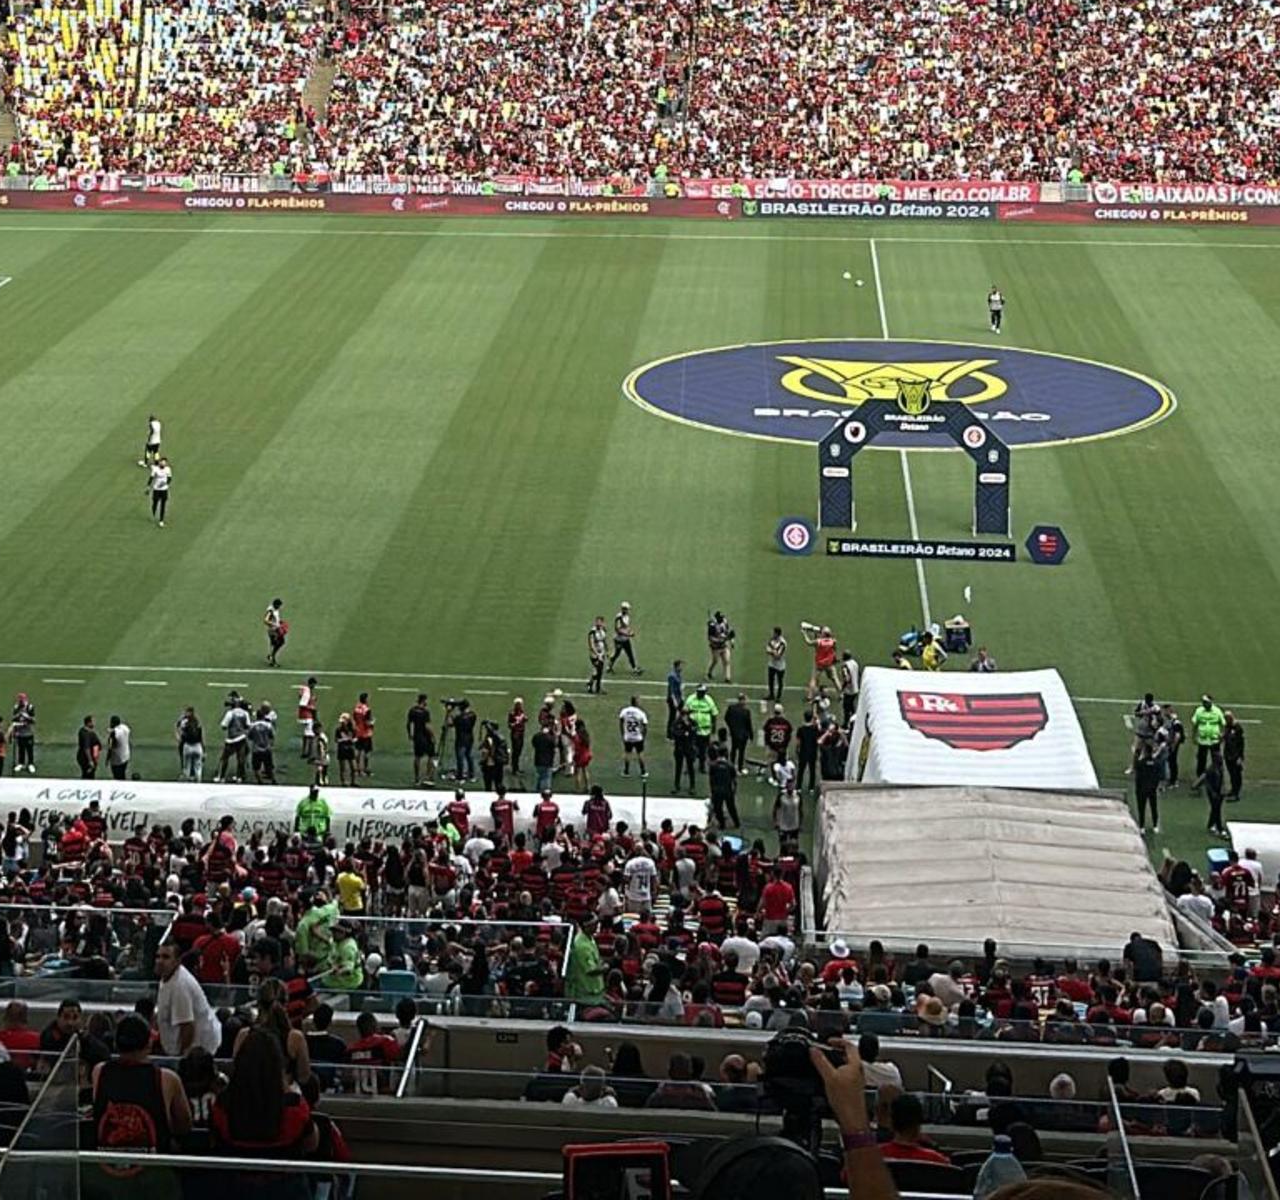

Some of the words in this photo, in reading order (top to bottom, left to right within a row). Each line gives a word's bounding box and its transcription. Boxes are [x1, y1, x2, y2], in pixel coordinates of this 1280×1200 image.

[712, 183, 751, 199] SEA
[185, 197, 233, 208] CHEGOU
[760, 201, 886, 216] BRASILEIRÃO
[946, 205, 991, 218] 2024
[1094, 208, 1147, 220] CHEGOU
[1150, 209, 1161, 220] O
[841, 541, 934, 556] BRASILEIRÃO
[978, 547, 1011, 558] 2024
[1031, 985, 1049, 1007] 37
